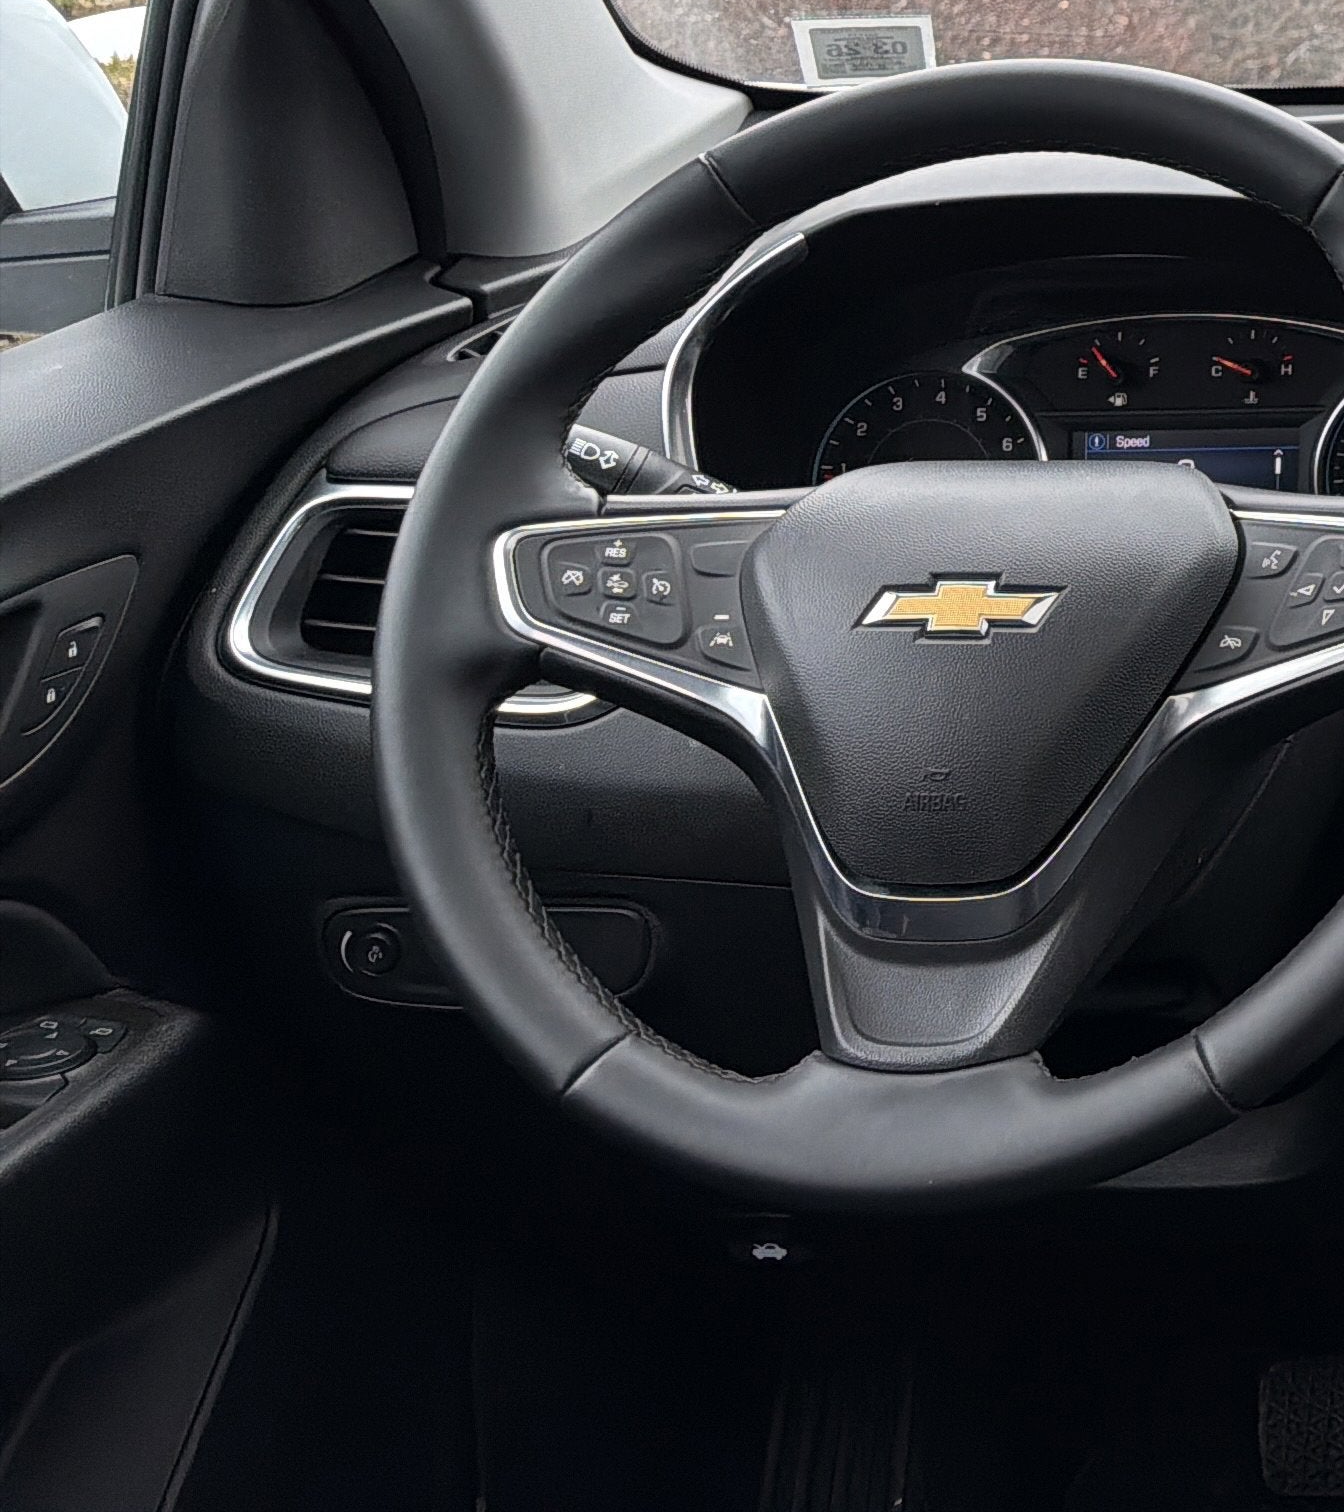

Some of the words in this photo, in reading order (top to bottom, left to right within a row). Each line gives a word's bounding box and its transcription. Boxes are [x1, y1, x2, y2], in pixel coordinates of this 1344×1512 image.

[1077, 366, 1088, 379] E
[1149, 365, 1160, 378] F
[1211, 365, 1223, 378] C
[1280, 363, 1293, 376] H
[892, 397, 903, 411] 3
[935, 391, 946, 405] 4
[976, 407, 987, 422] 5
[856, 422, 868, 437] 2
[1002, 437, 1013, 452] 6
[1115, 434, 1150, 450] Speed
[604, 547, 628, 559] RES
[608, 612, 631, 624] SET
[901, 791, 968, 812] AIRBAG
